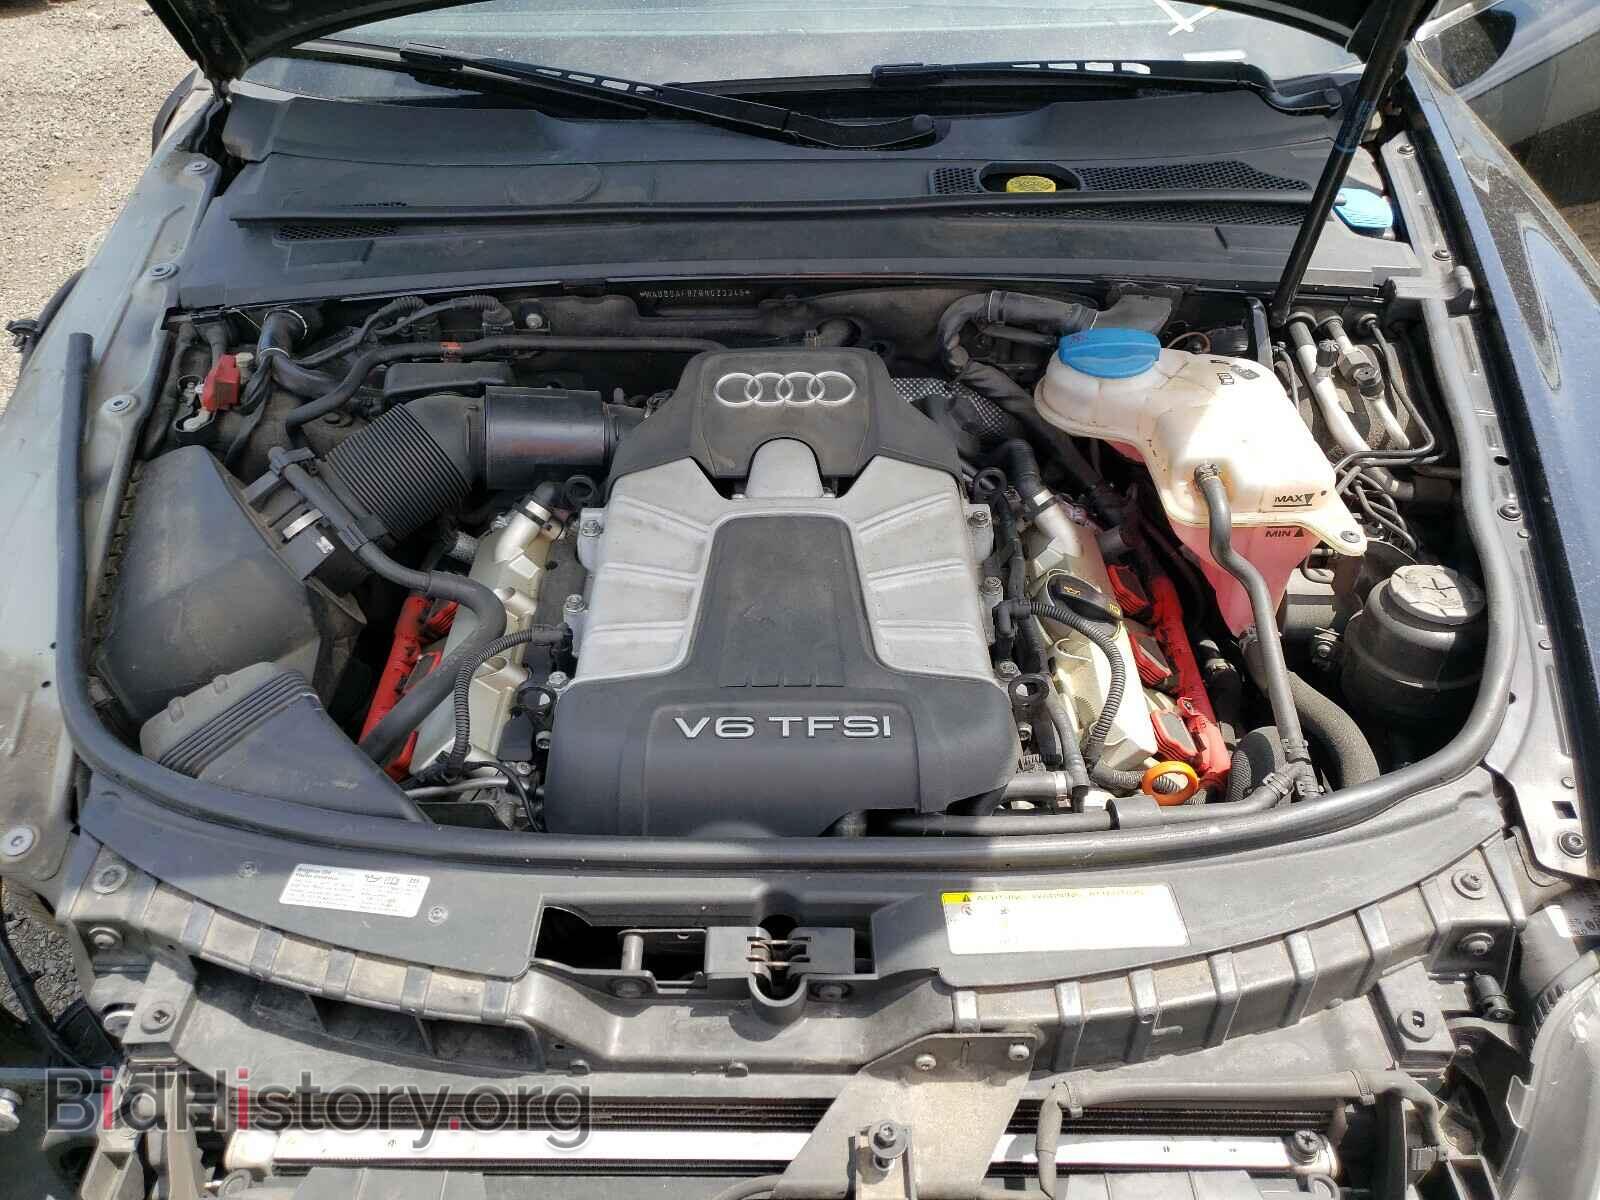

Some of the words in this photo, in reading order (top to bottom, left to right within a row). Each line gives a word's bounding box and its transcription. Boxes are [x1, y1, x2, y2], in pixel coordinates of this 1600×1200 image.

[1274, 495, 1304, 503] MAX
[1265, 530, 1292, 538] MIN
[674, 716, 755, 738] V6
[768, 716, 891, 738] TFSI
